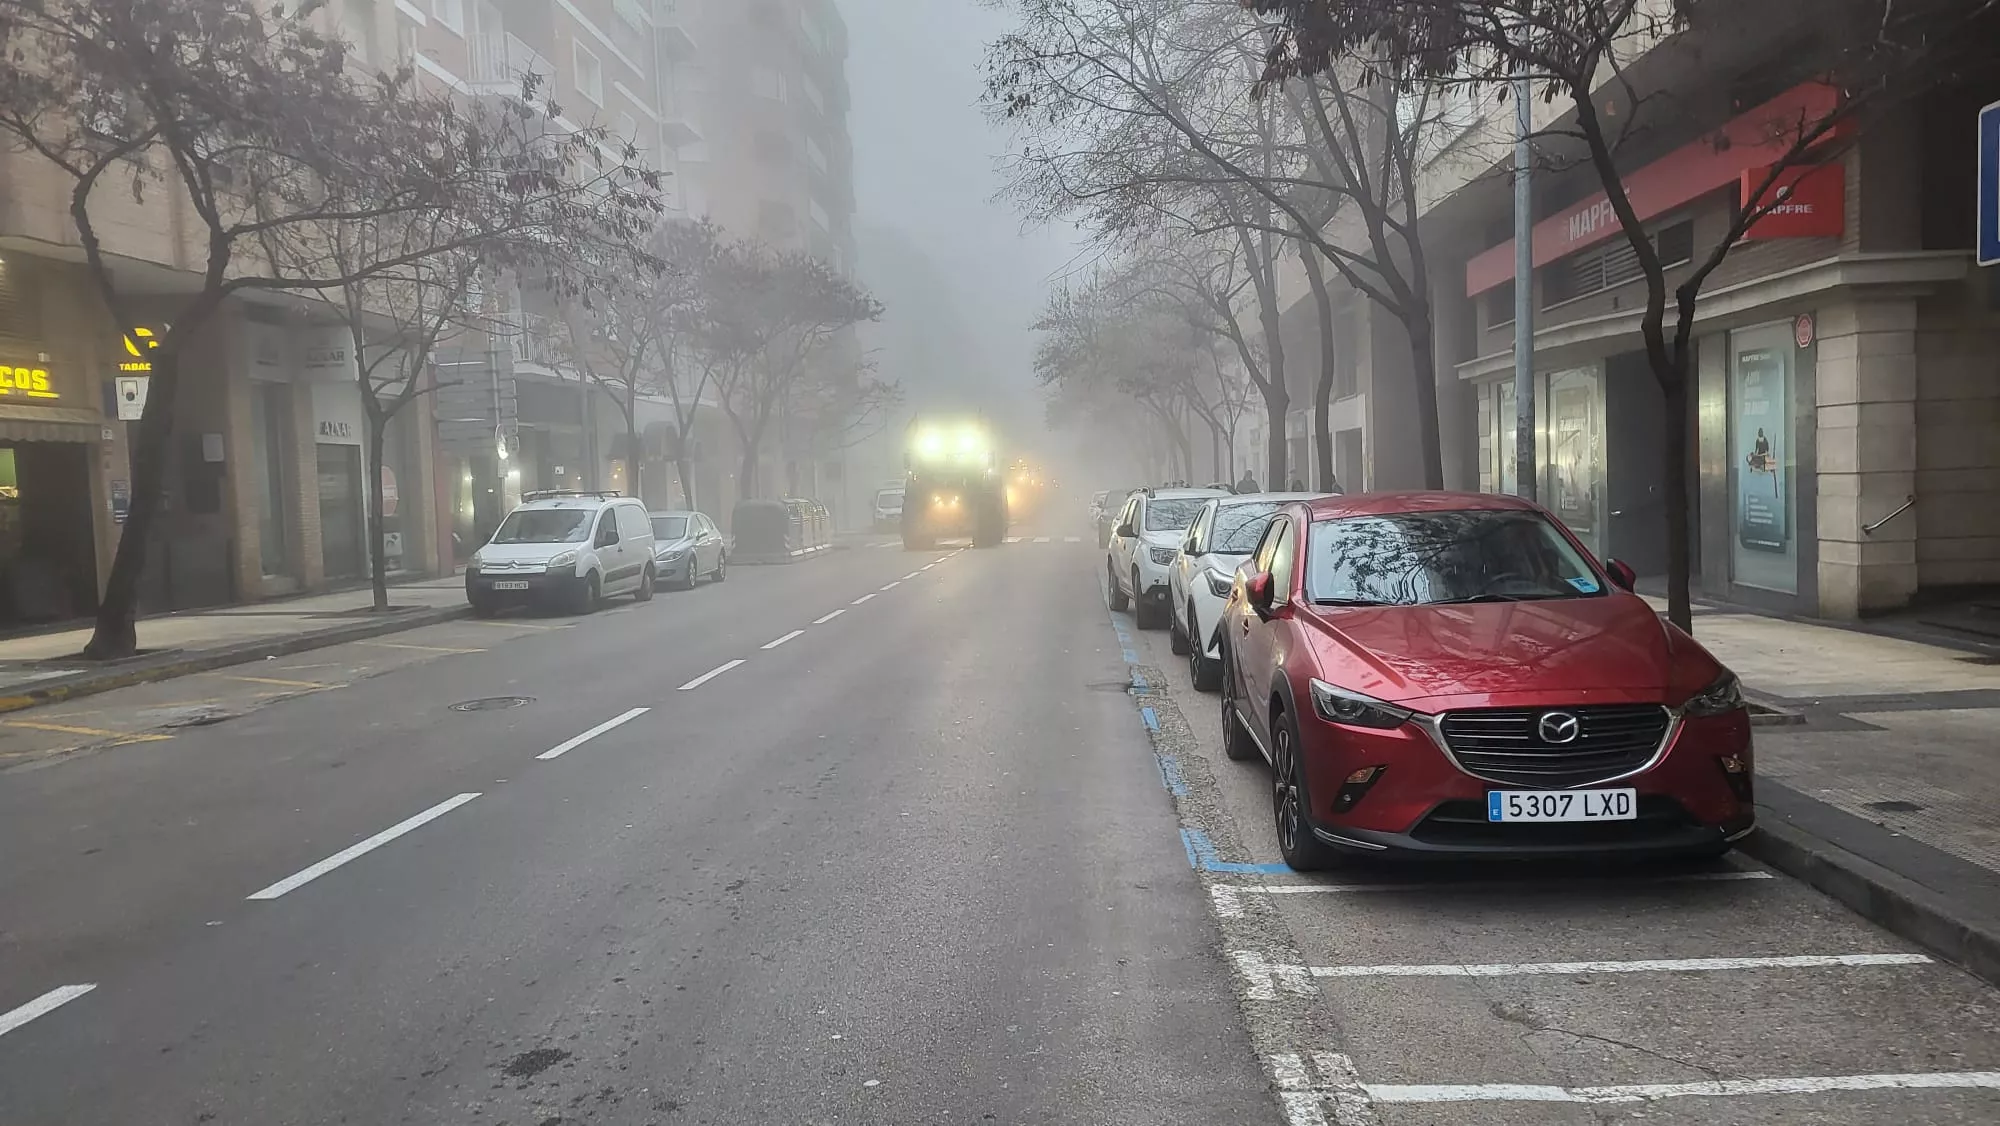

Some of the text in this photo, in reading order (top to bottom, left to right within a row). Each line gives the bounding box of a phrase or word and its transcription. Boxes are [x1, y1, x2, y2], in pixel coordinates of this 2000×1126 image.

[1492, 792, 1630, 818] E 5307 LXD
